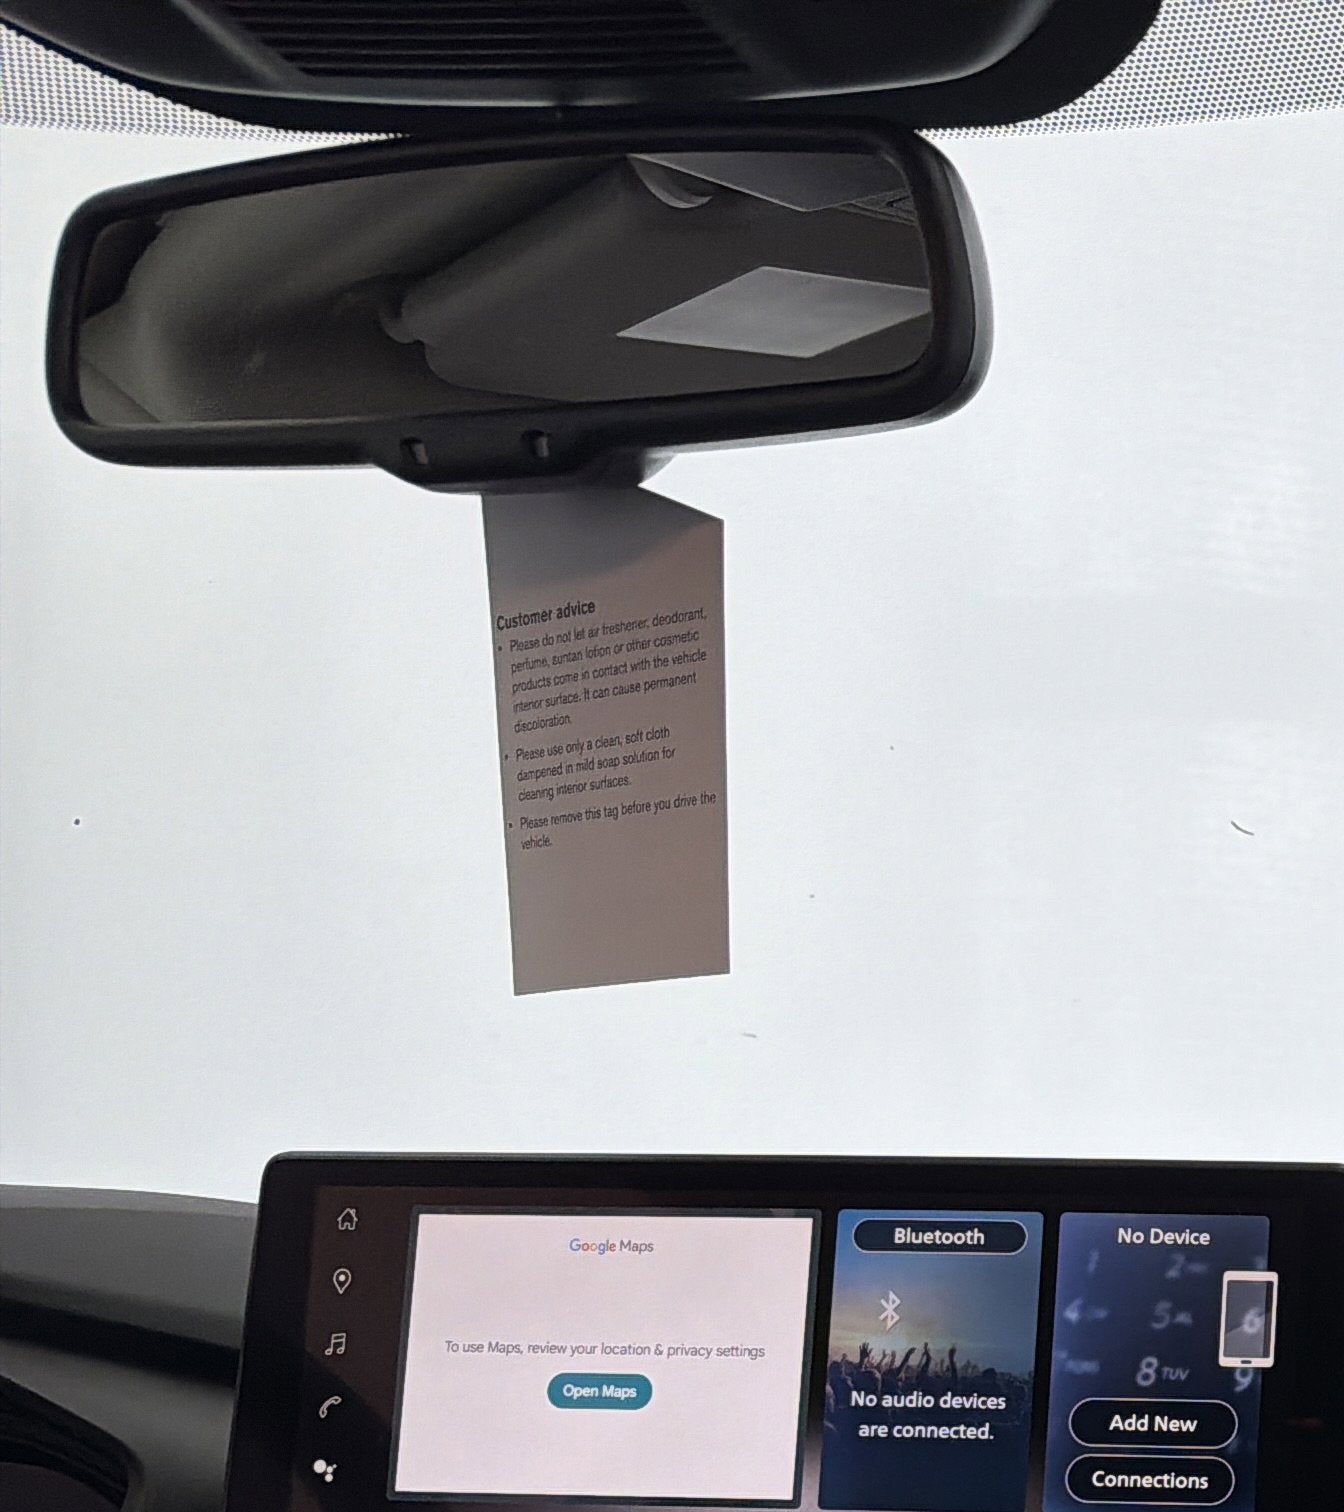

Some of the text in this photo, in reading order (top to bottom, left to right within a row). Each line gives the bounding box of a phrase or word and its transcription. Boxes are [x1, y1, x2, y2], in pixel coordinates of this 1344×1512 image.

[496, 601, 595, 631] Customer advice
[519, 791, 716, 829] Please remove this tag before you drive the
[568, 1237, 654, 1255] Google Maps
[893, 1228, 985, 1246] Bluetooth
[1117, 1229, 1211, 1246] No Device
[444, 1340, 765, 1360] To use Maps, review your location & privacy settings
[1135, 1355, 1190, 1387] 8 TUV
[562, 1383, 637, 1400] Open Maps
[850, 1392, 1006, 1410] No audio devices
[858, 1421, 995, 1440] are connected.
[1109, 1415, 1198, 1433] Add New
[1091, 1471, 1209, 1490] Connections
